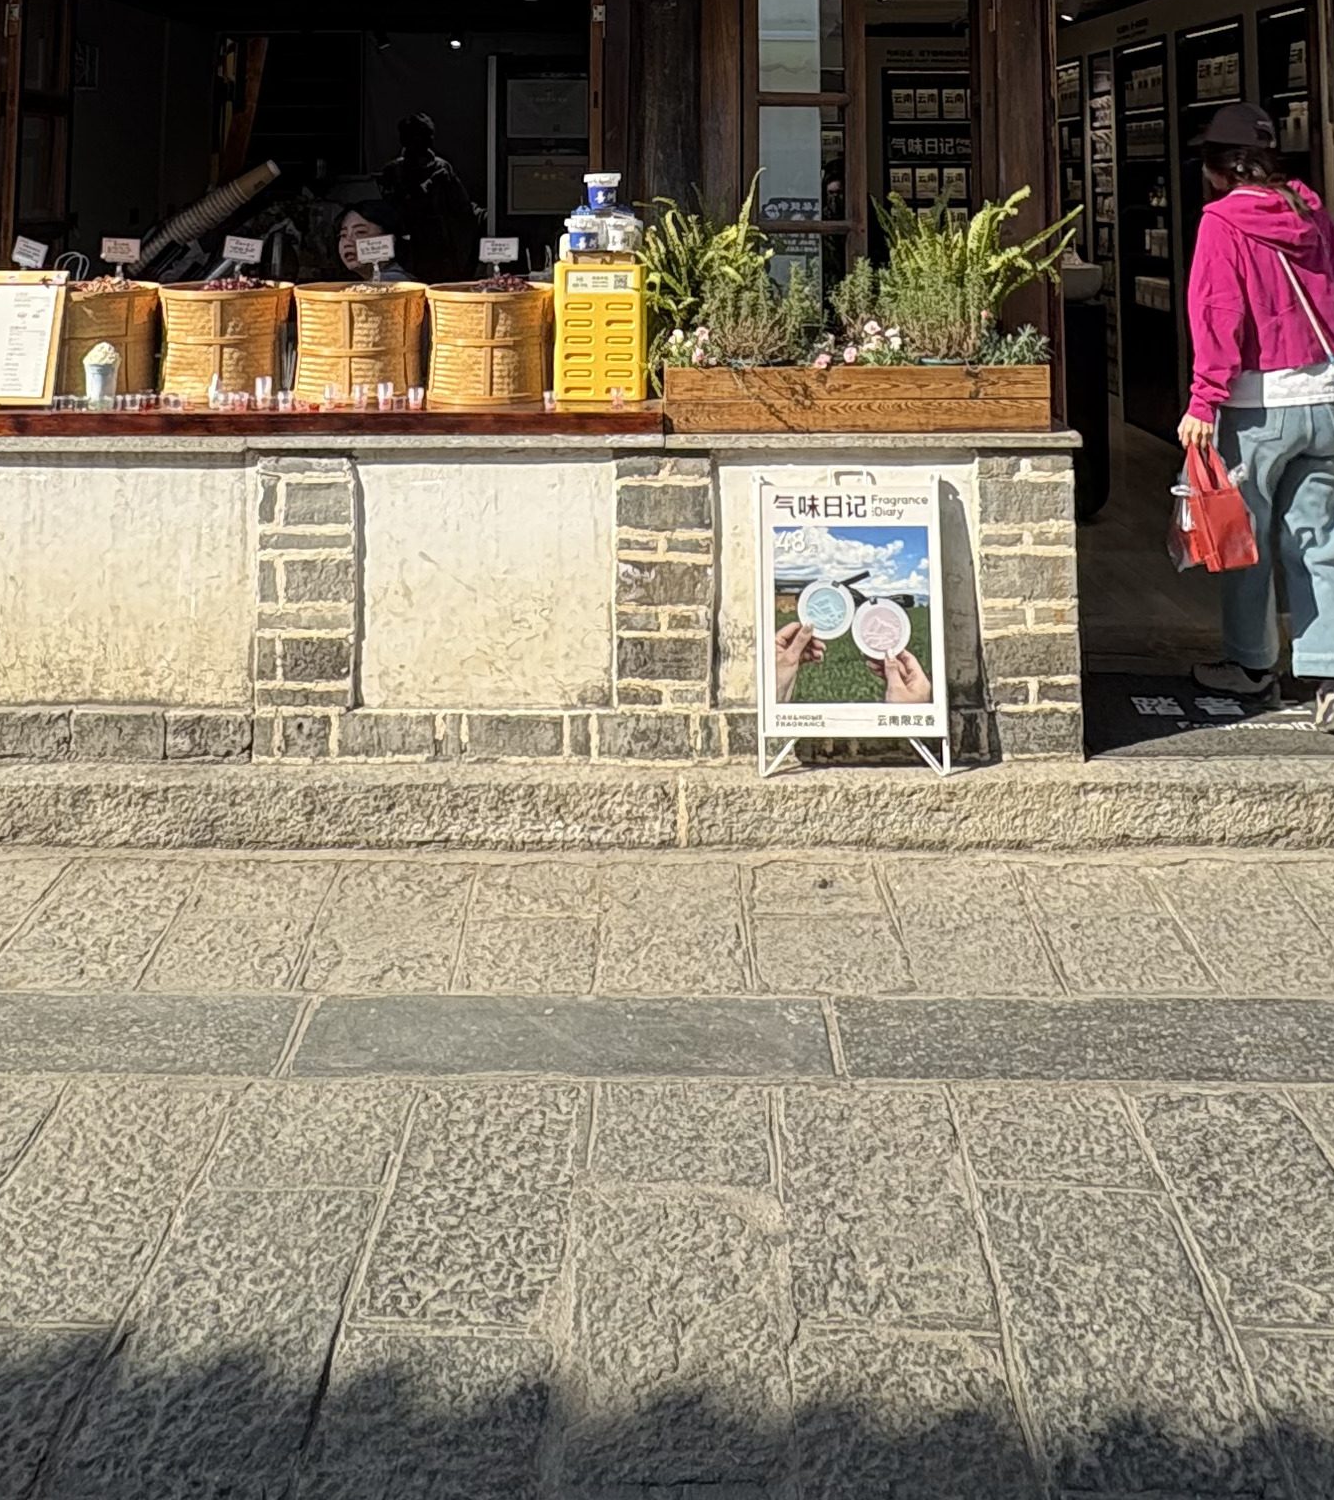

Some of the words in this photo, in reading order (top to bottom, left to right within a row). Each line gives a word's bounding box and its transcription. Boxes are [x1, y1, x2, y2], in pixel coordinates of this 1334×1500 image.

[891, 137, 955, 155] 气味日记
[773, 494, 867, 519] 气味日记
[871, 495, 929, 509] Fragrance
